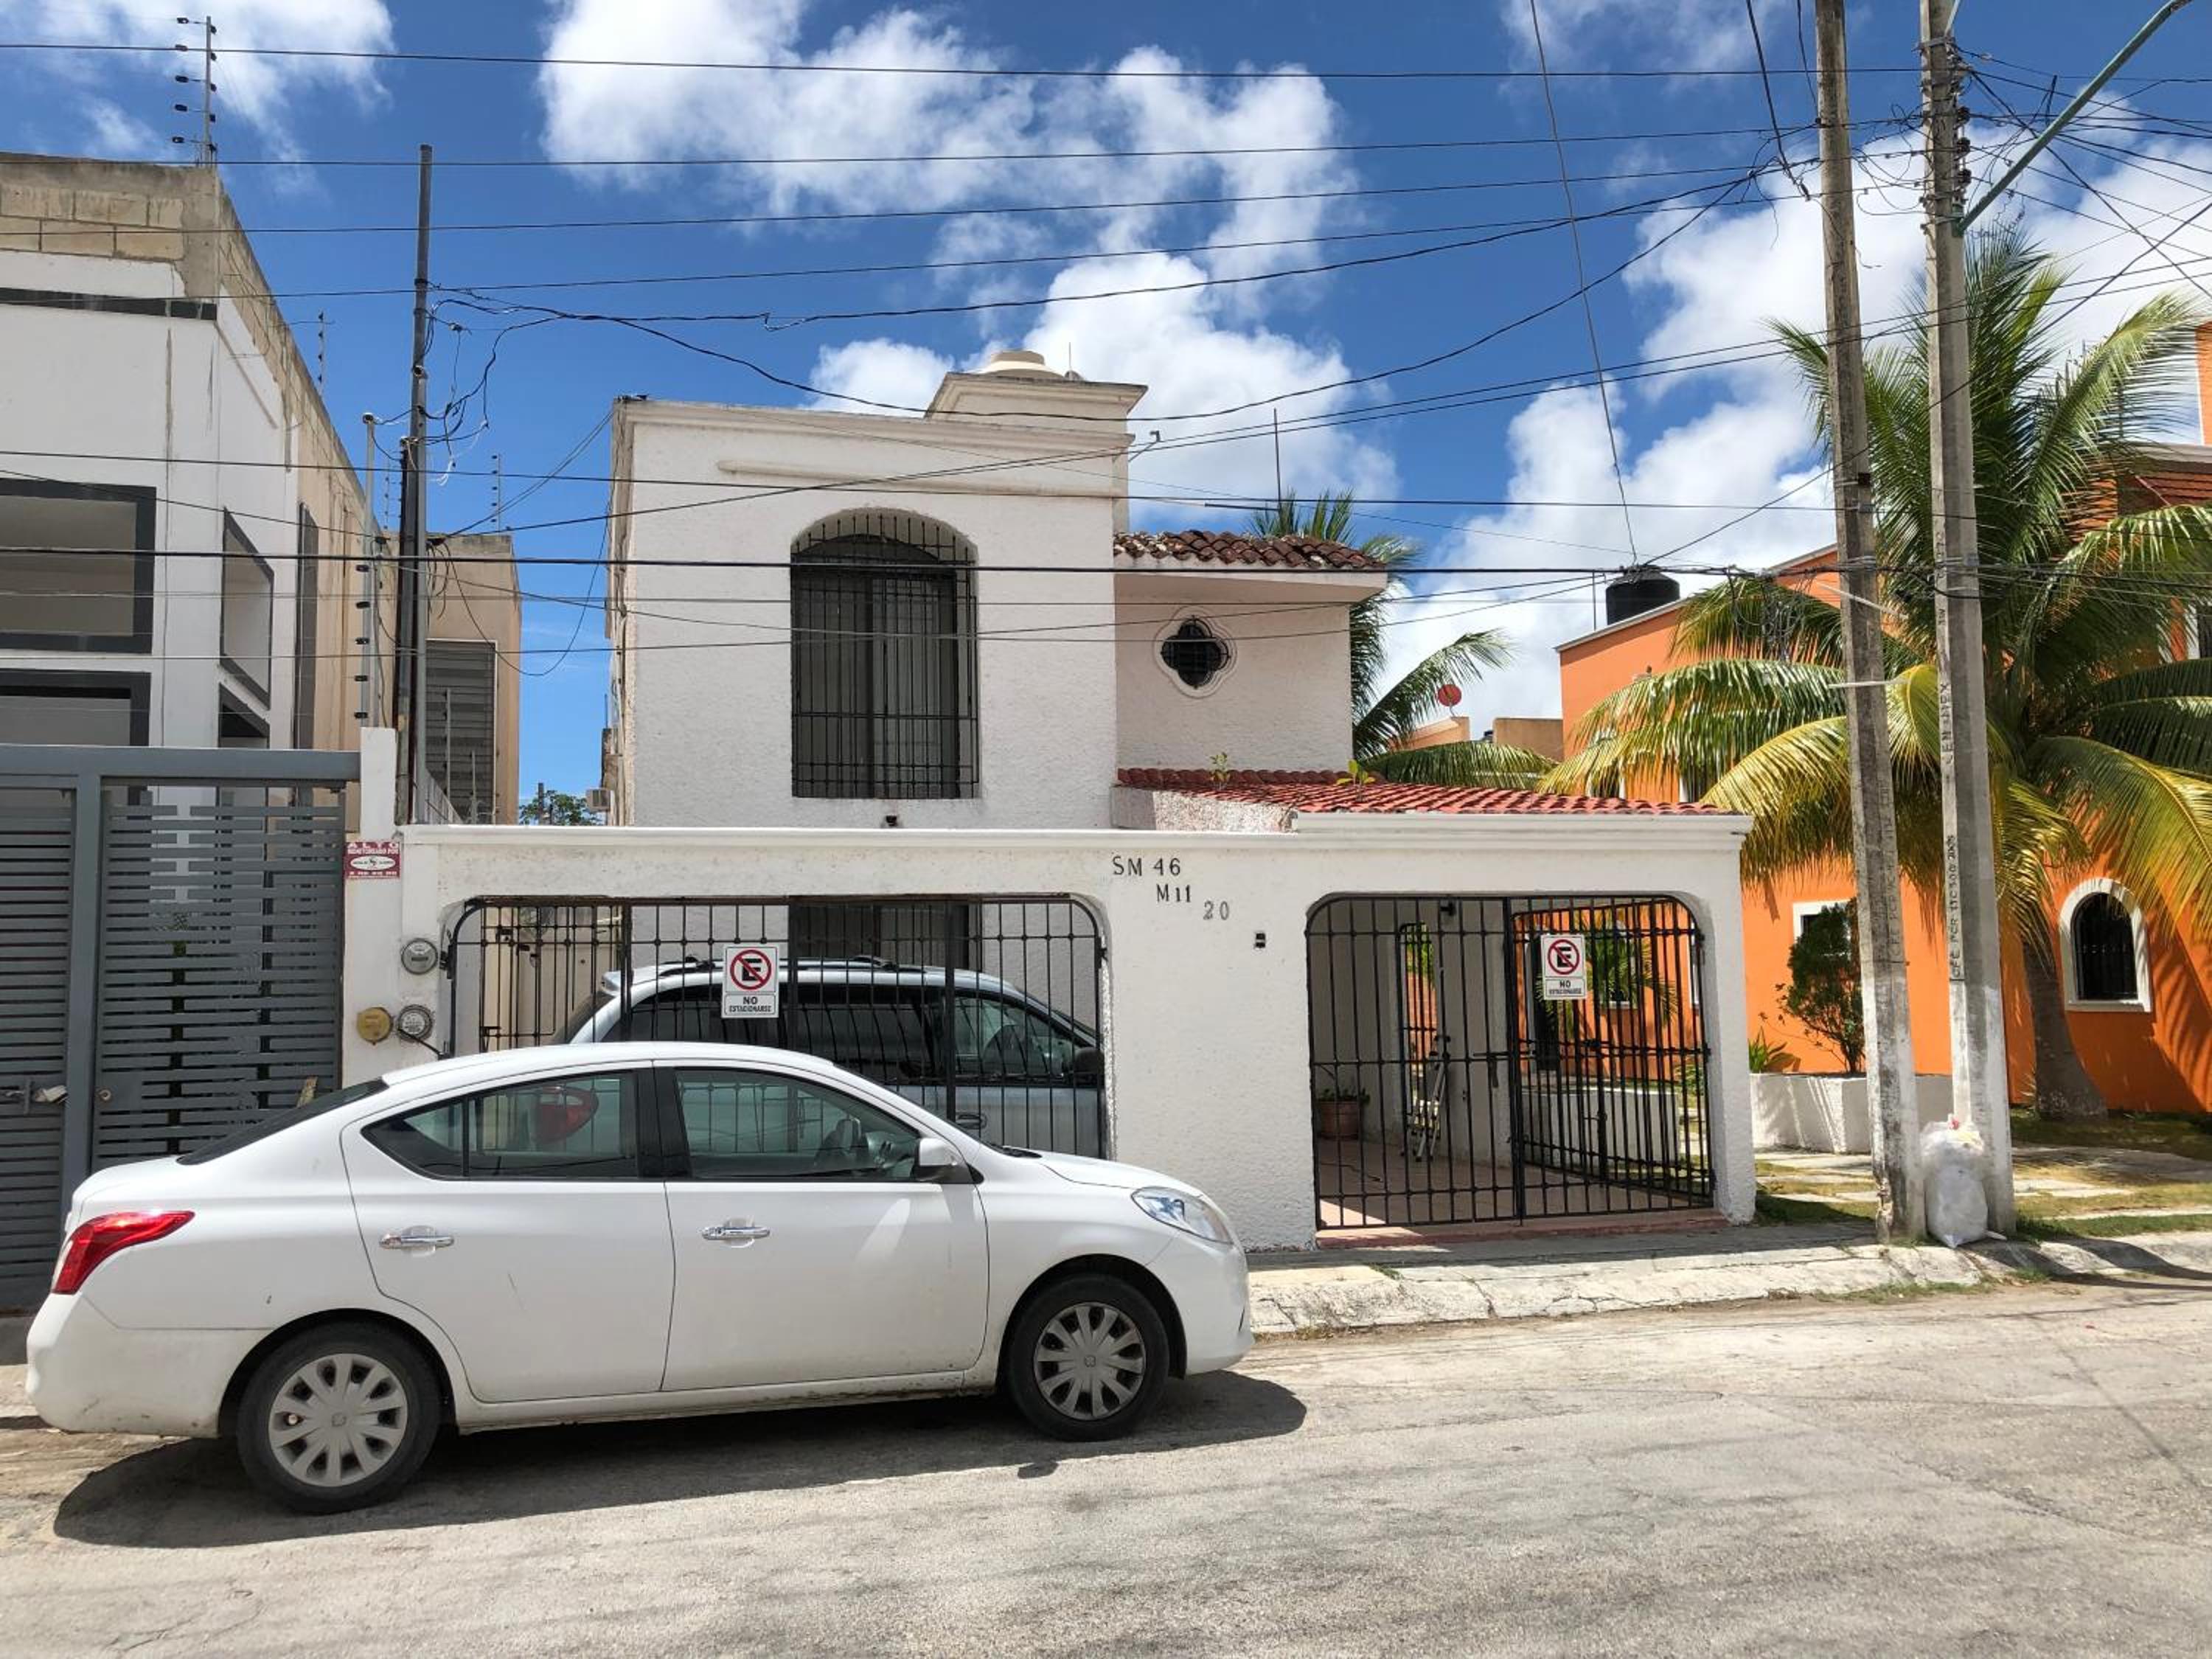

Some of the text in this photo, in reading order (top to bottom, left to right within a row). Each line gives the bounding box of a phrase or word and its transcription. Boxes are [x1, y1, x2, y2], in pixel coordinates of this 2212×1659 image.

[1112, 855, 1181, 876] SM 46
[1203, 900, 1230, 920] 20
[1559, 980, 1571, 988] NO
[742, 996, 759, 1004] NO
